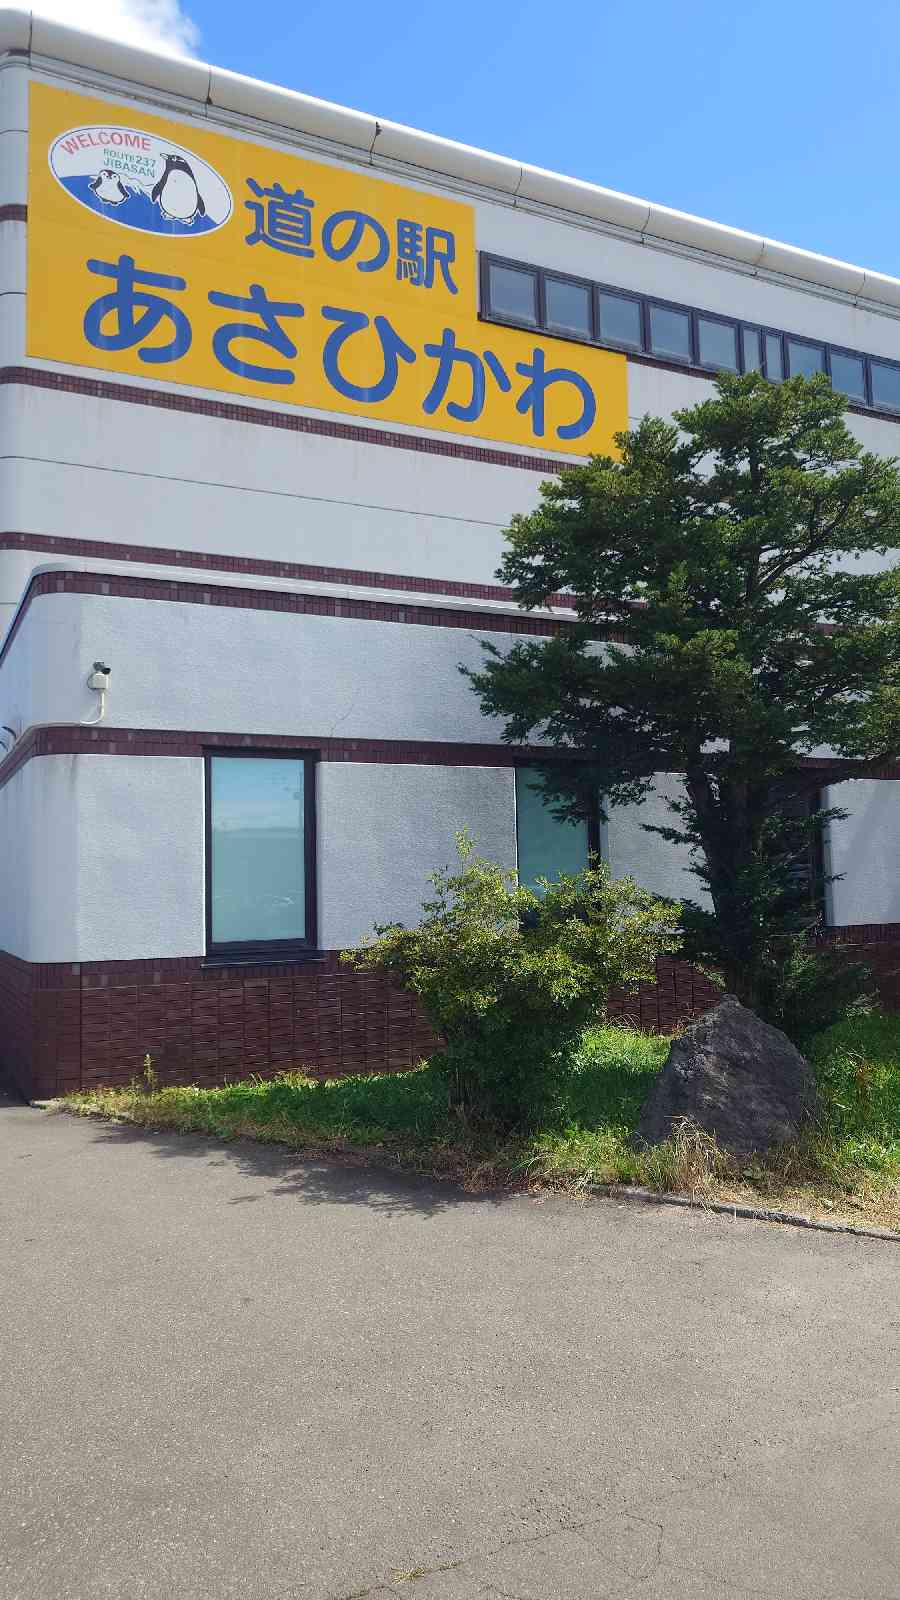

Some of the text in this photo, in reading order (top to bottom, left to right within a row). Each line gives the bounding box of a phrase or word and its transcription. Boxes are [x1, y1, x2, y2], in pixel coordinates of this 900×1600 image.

[60, 131, 152, 155] WELCOME
[103, 158, 155, 178] JIBASAN
[246, 179, 458, 294] 道の駅
[84, 256, 595, 439] あさひかわ
